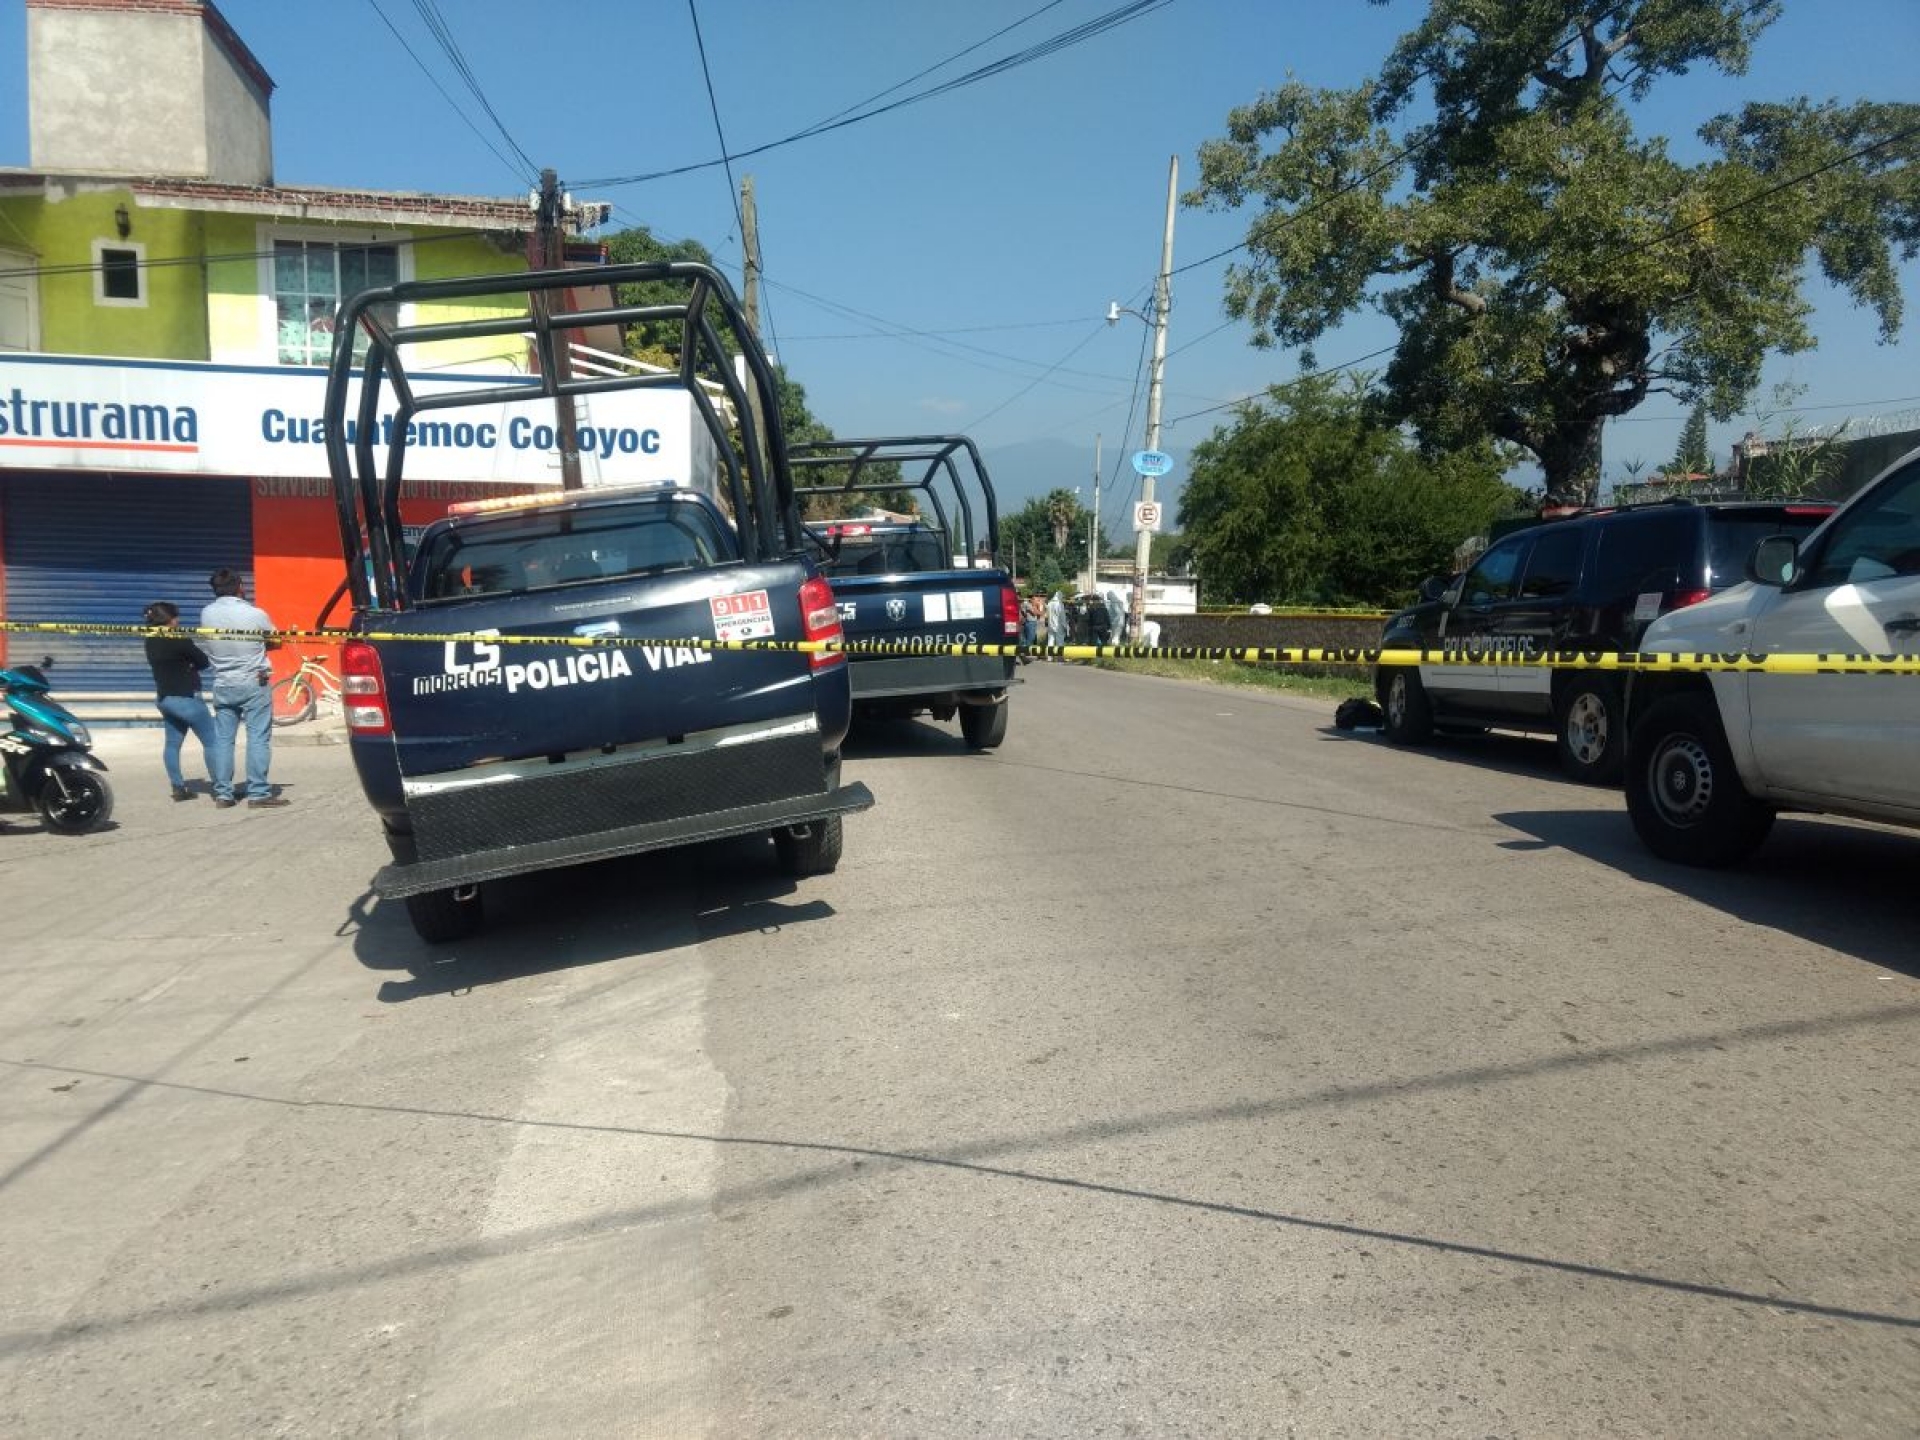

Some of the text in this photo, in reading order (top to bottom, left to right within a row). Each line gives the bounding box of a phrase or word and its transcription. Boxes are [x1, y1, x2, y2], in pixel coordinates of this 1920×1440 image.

[509, 416, 660, 459] Cooyoc
[716, 595, 763, 615] 911
[716, 615, 770, 629] EMERGENCIAS
[895, 631, 977, 647] MORELOS
[505, 637, 712, 694] POLICIA VIAL
[413, 667, 501, 695] MORELOS
